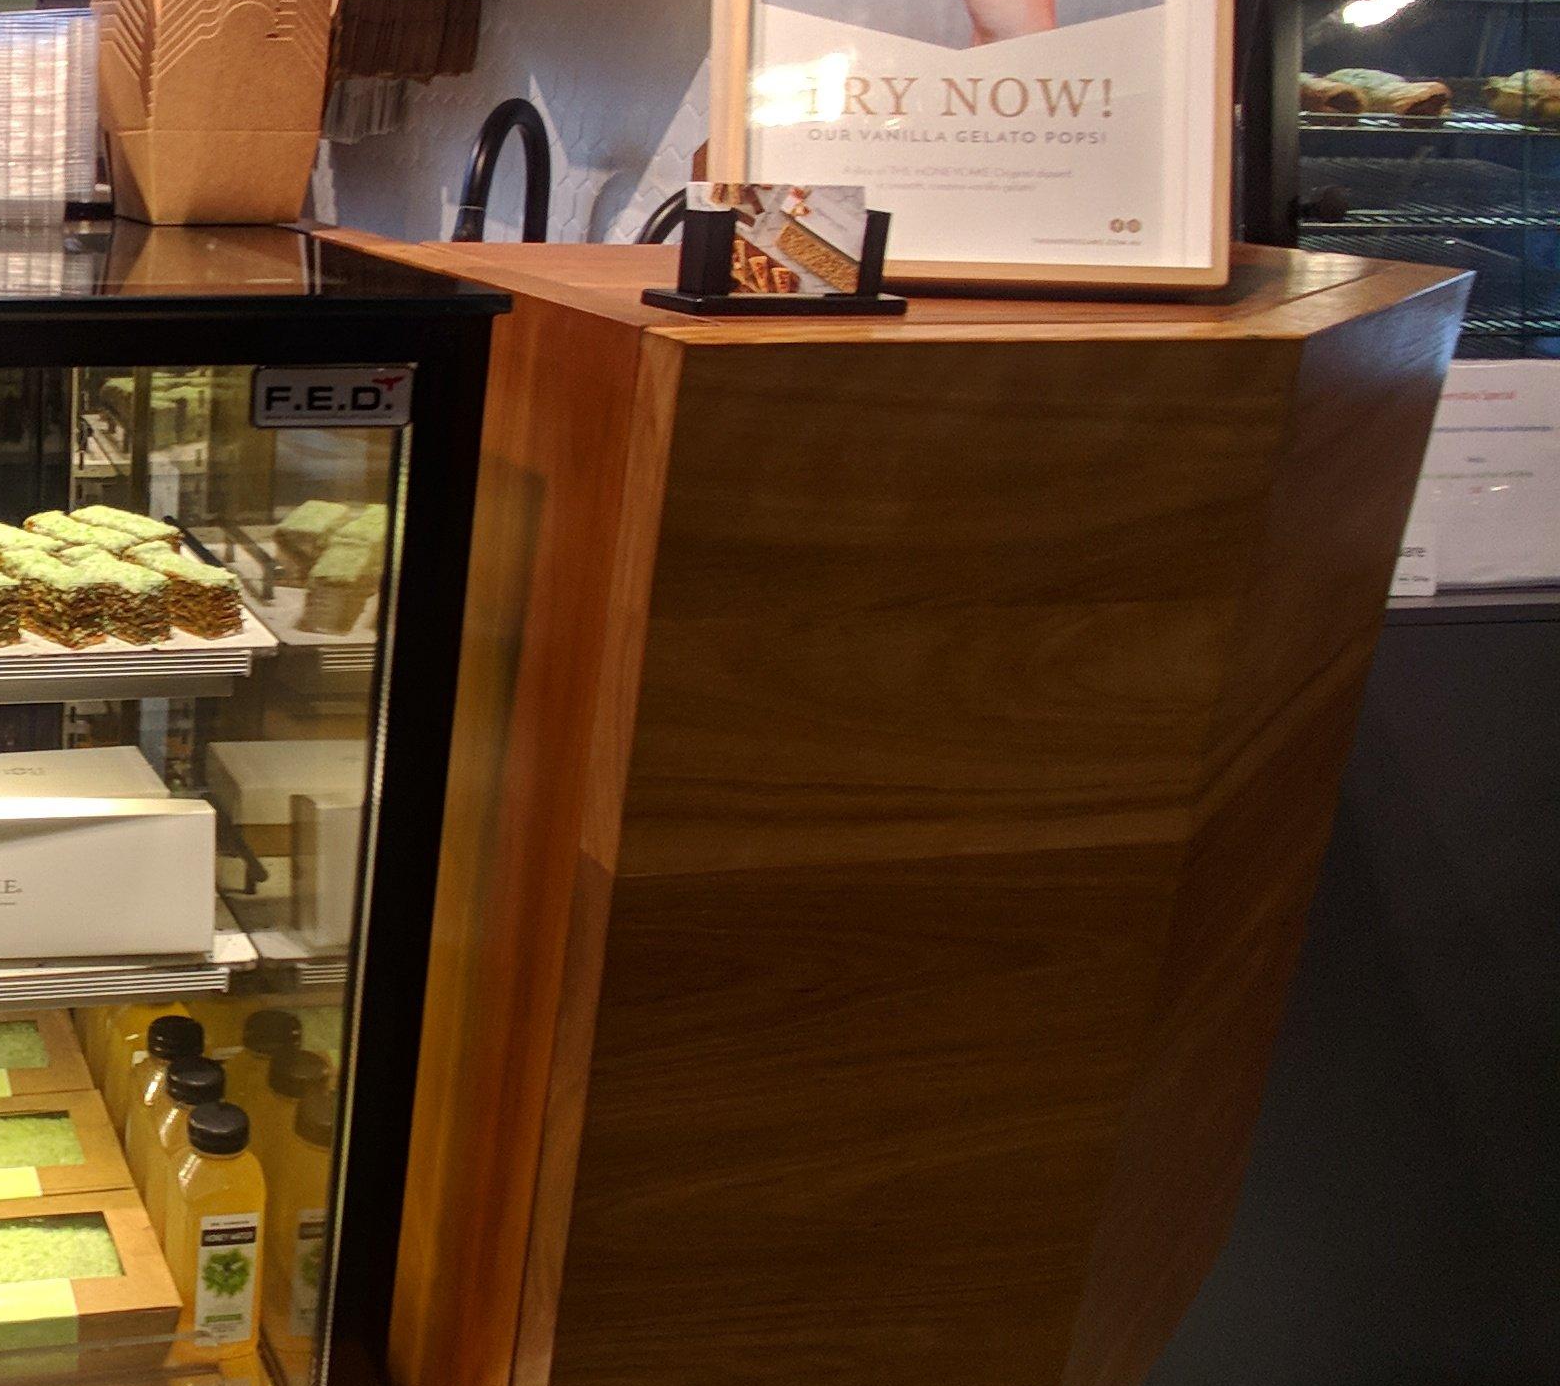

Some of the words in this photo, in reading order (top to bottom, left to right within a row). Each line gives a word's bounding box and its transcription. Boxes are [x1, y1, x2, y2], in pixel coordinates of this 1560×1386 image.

[940, 76, 1114, 119] NOW!
[807, 128, 851, 143] OUR
[859, 129, 947, 144] VANILLA
[954, 130, 1038, 145] GELATO
[1044, 131, 1107, 145] POPS!
